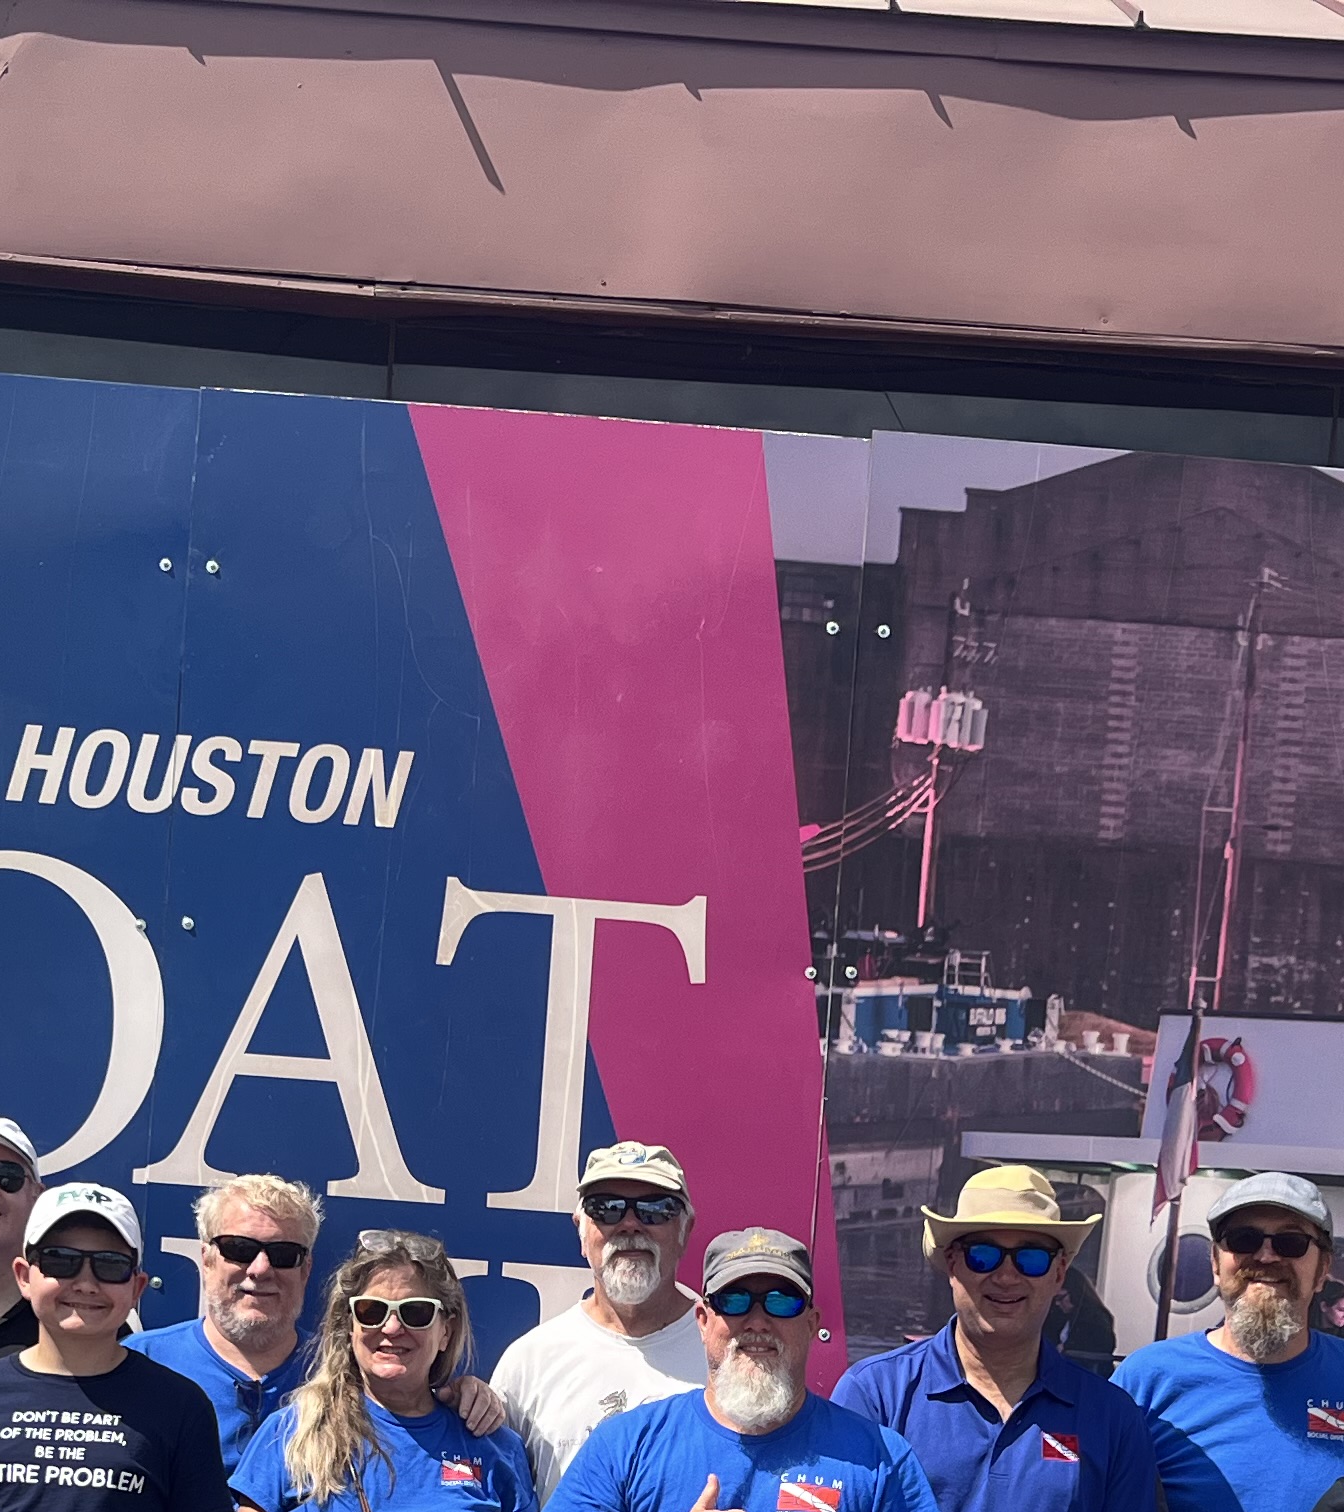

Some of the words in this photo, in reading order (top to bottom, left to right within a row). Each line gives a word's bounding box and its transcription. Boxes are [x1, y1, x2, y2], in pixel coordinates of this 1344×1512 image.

[5, 723, 415, 829] HOUSTON
[11, 1409, 59, 1423] DON'T
[60, 1411, 80, 1424] BE
[82, 1412, 121, 1426] PART
[0, 1427, 21, 1439] OF
[24, 1427, 52, 1440] THE
[54, 1428, 127, 1446] PROBLEM,
[34, 1445, 55, 1458] BE
[57, 1446, 86, 1460] THE
[440, 1450, 482, 1465] CHM
[44, 1465, 145, 1494] PROBLEM
[780, 1472, 843, 1489] CHUM
